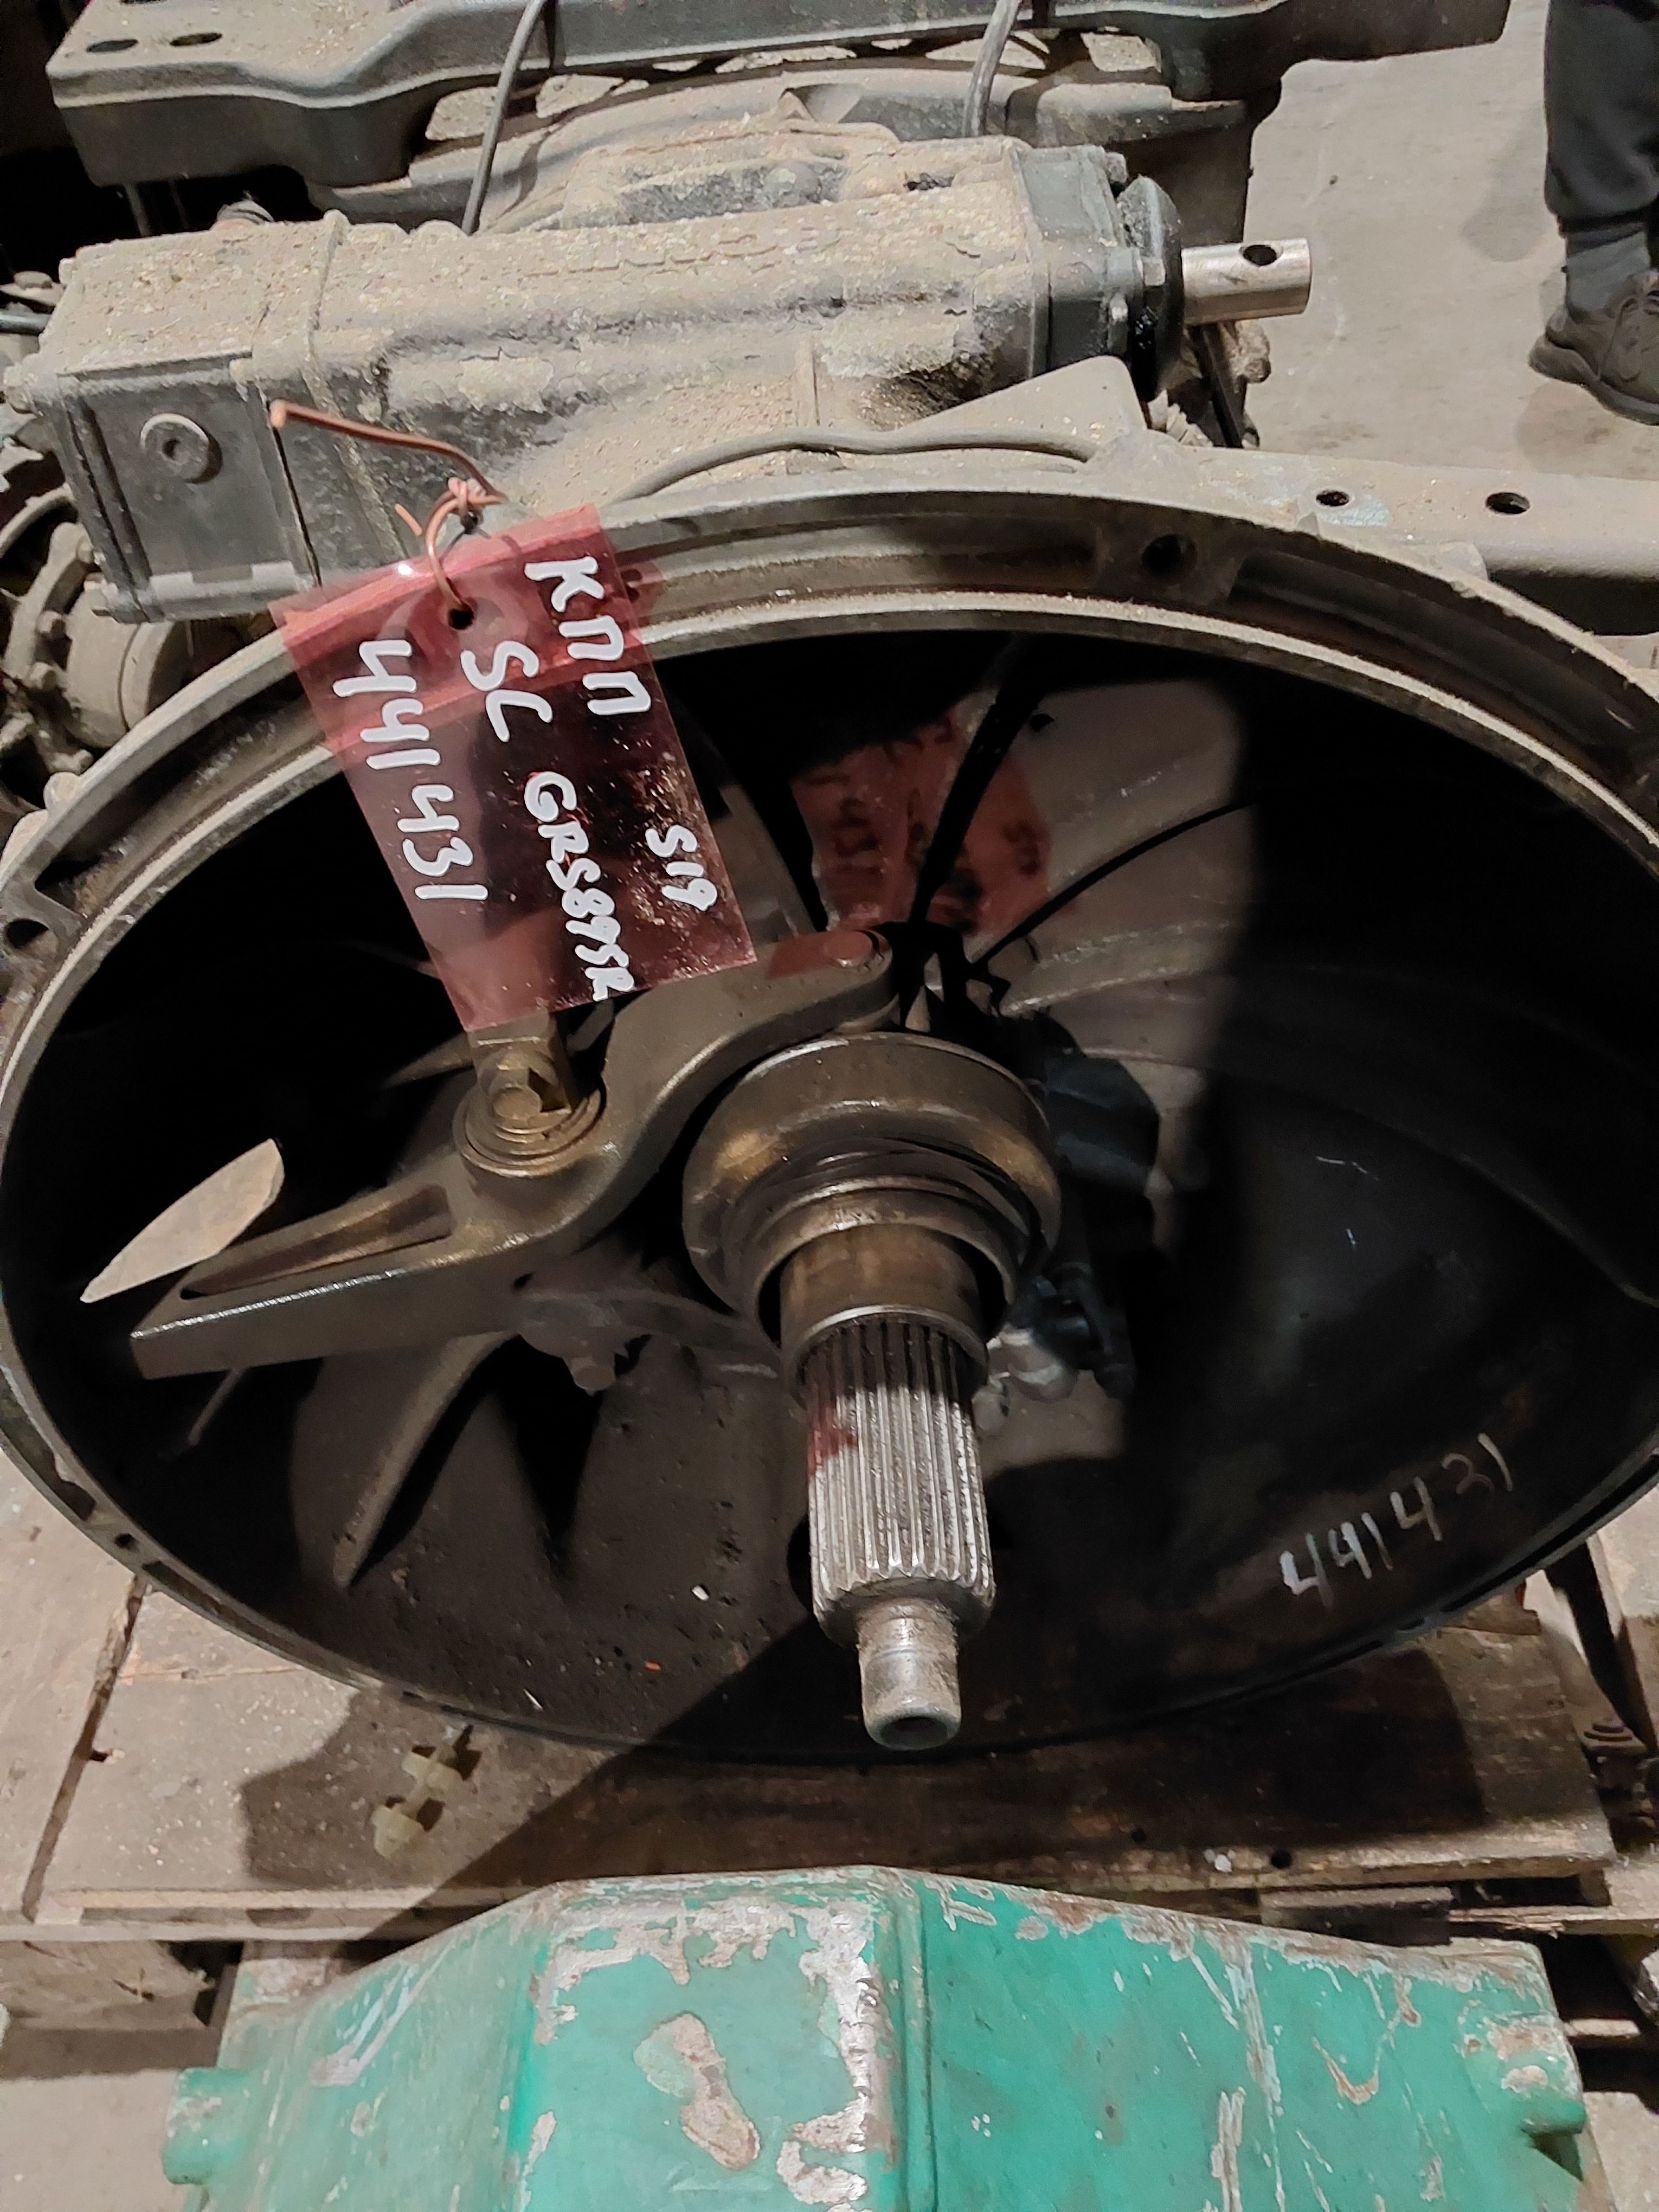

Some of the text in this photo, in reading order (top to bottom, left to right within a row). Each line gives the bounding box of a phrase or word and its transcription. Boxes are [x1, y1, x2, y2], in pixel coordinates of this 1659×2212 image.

[459, 640, 635, 1003] SC GRS895R
[644, 824, 718, 912] S19
